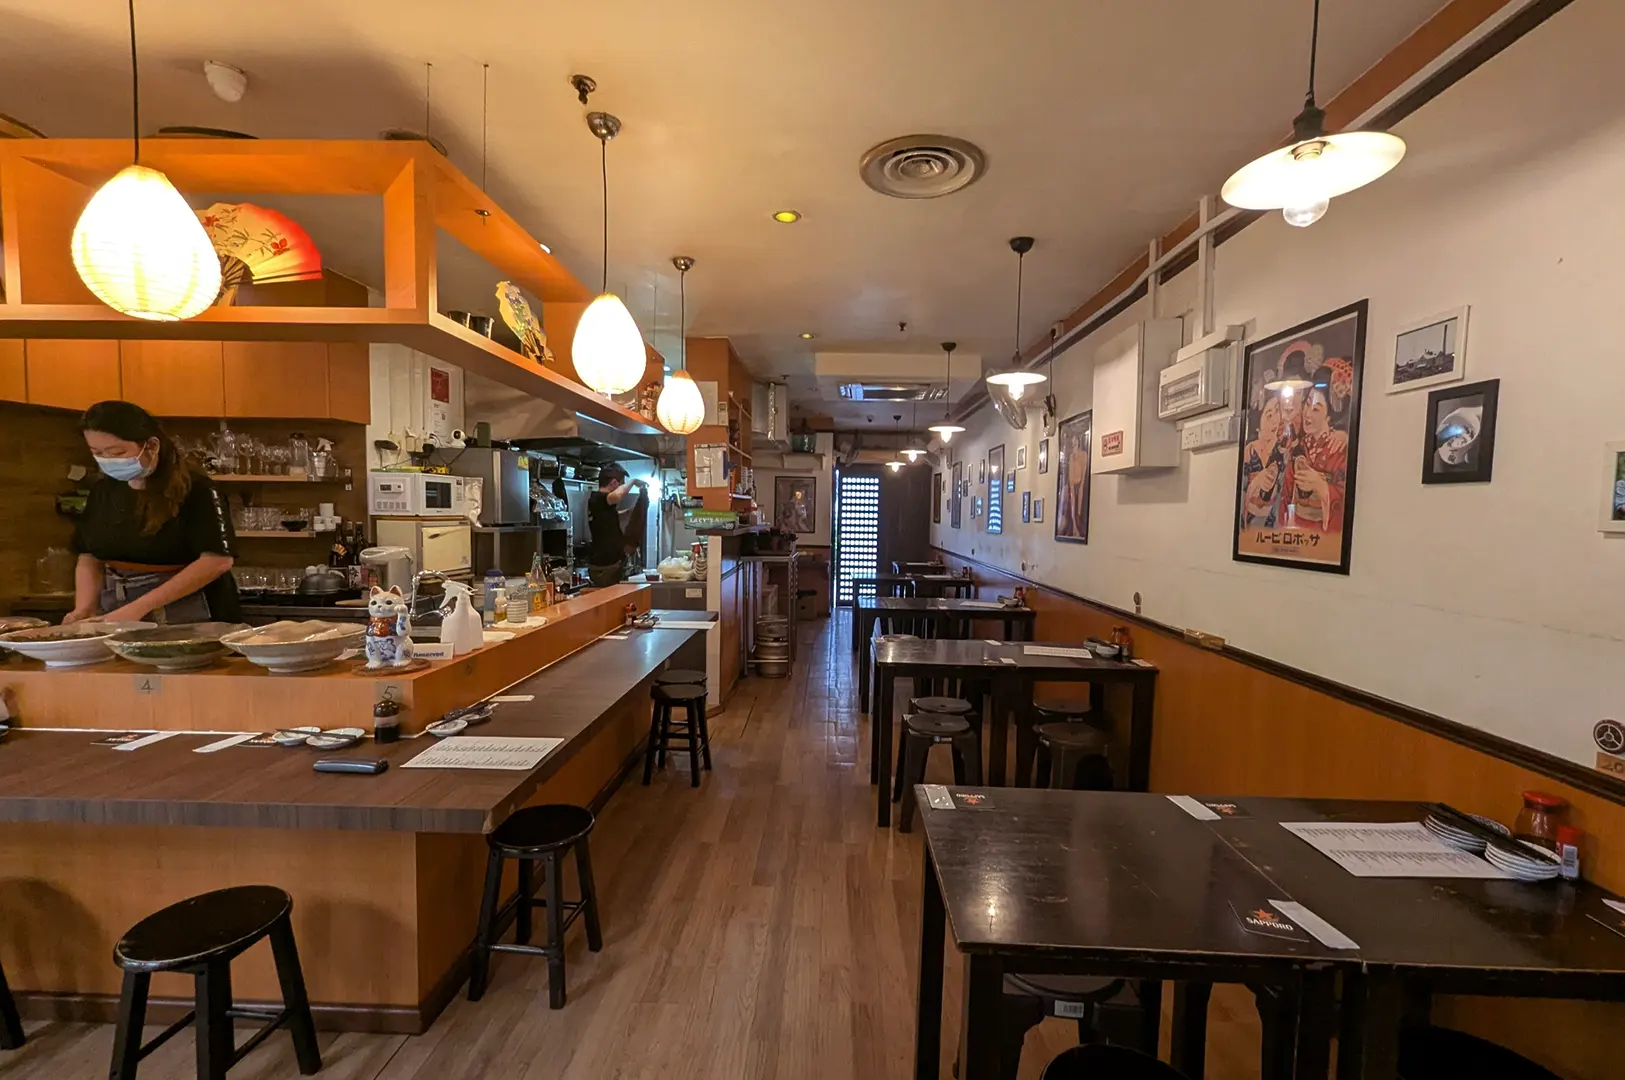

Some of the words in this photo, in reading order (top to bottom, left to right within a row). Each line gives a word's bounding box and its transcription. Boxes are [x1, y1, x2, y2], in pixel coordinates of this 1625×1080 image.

[140, 678, 154, 694] 4
[381, 685, 398, 700] 5
[1245, 916, 1294, 931] SAPPORO
